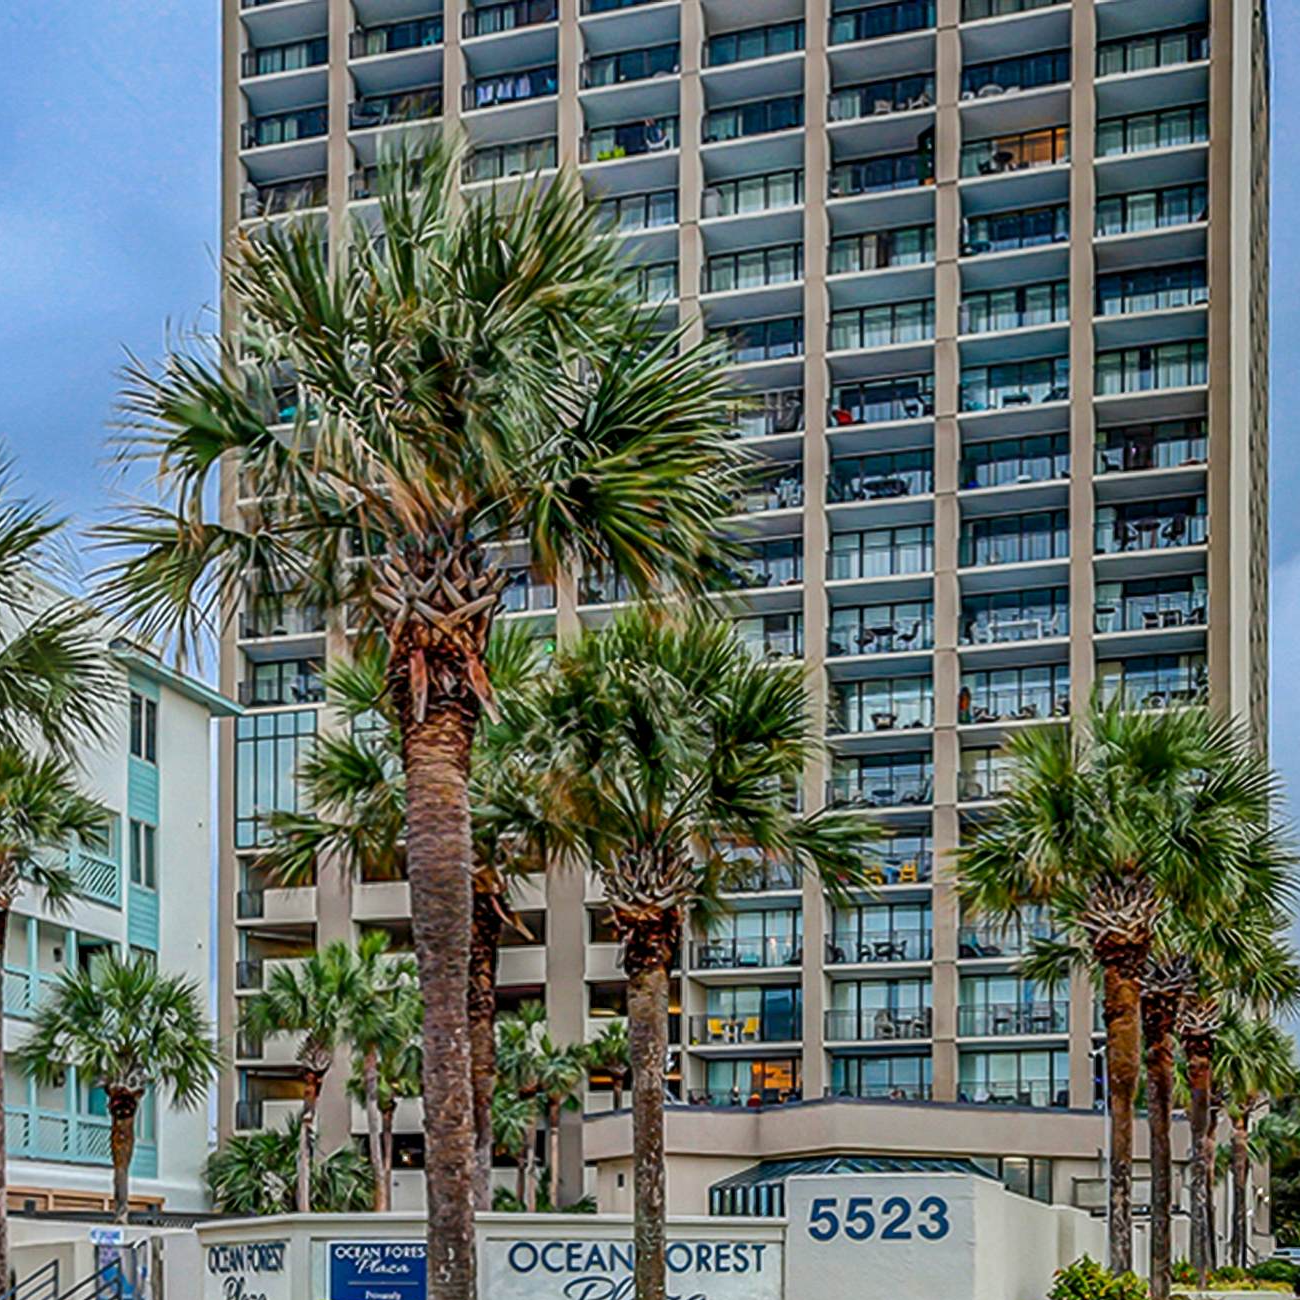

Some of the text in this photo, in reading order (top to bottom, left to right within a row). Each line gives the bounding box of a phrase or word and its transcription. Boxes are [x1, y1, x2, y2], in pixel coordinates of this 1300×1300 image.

[808, 1196, 950, 1241] 5523
[207, 1243, 286, 1274] OCEAN FOREST
[334, 1246, 427, 1259] OCEAN FORES
[354, 1252, 411, 1274] Plaza
[508, 1242, 766, 1273] OCEAN OREST
